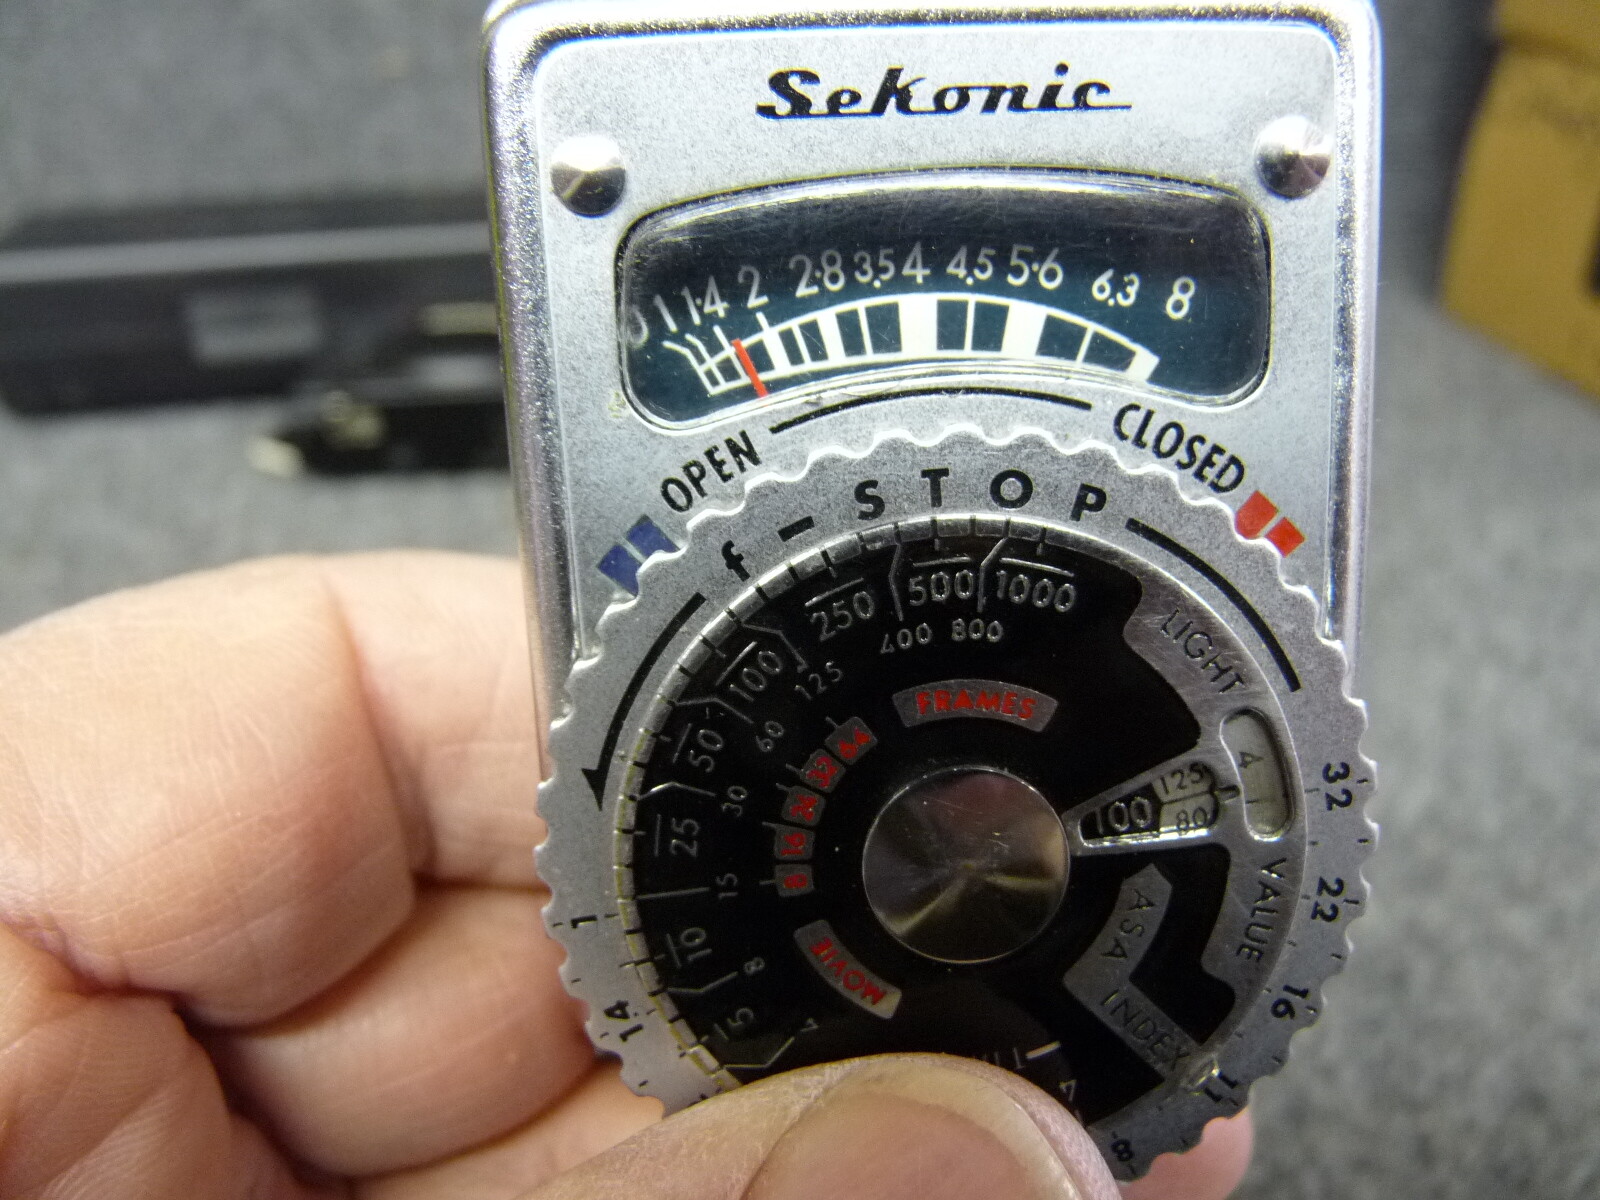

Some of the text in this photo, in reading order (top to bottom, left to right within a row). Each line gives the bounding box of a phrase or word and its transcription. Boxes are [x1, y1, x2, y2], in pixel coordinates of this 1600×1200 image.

[756, 61, 1133, 120] Sekonic
[653, 294, 678, 332] 1
[737, 265, 769, 309] 2
[853, 249, 896, 289] 3.5
[902, 241, 931, 284] 4
[946, 246, 996, 286] 4.5
[1091, 268, 1141, 307] 6.3
[1165, 276, 1196, 320] 8
[1113, 402, 1247, 495] CLOSED
[660, 430, 763, 515] OPEN
[909, 569, 975, 607] 500
[996, 569, 1077, 613] 1000
[810, 591, 875, 643] 250
[951, 617, 1004, 643] 800
[880, 622, 933, 655] 400
[1160, 608, 1245, 695] LIGHT
[729, 650, 783, 702] 100
[794, 660, 843, 700] 125
[916, 689, 1038, 721] FRAMES
[690, 728, 724, 773] 50
[755, 720, 785, 752] 60
[1159, 761, 1205, 795] 125
[1239, 750, 1264, 769] 4
[721, 785, 748, 817] 30
[1322, 761, 1354, 812] 32
[1096, 796, 1154, 834] 100
[1175, 806, 1210, 835] 80
[670, 816, 700, 858] 25
[715, 872, 739, 899] 15
[783, 872, 808, 890] 8
[1310, 876, 1345, 924] 22
[570, 914, 598, 929] 1
[1235, 857, 1287, 963] VALUE
[680, 927, 713, 963] 10
[743, 956, 766, 976] 8
[809, 936, 888, 1006] MOVIE
[1100, 888, 1191, 1071] ASA INDEX
[726, 1007, 756, 1031] 5
[1270, 983, 1310, 1021] 16
[1204, 1071, 1239, 1105] 11
[1110, 1137, 1134, 1163] 8
